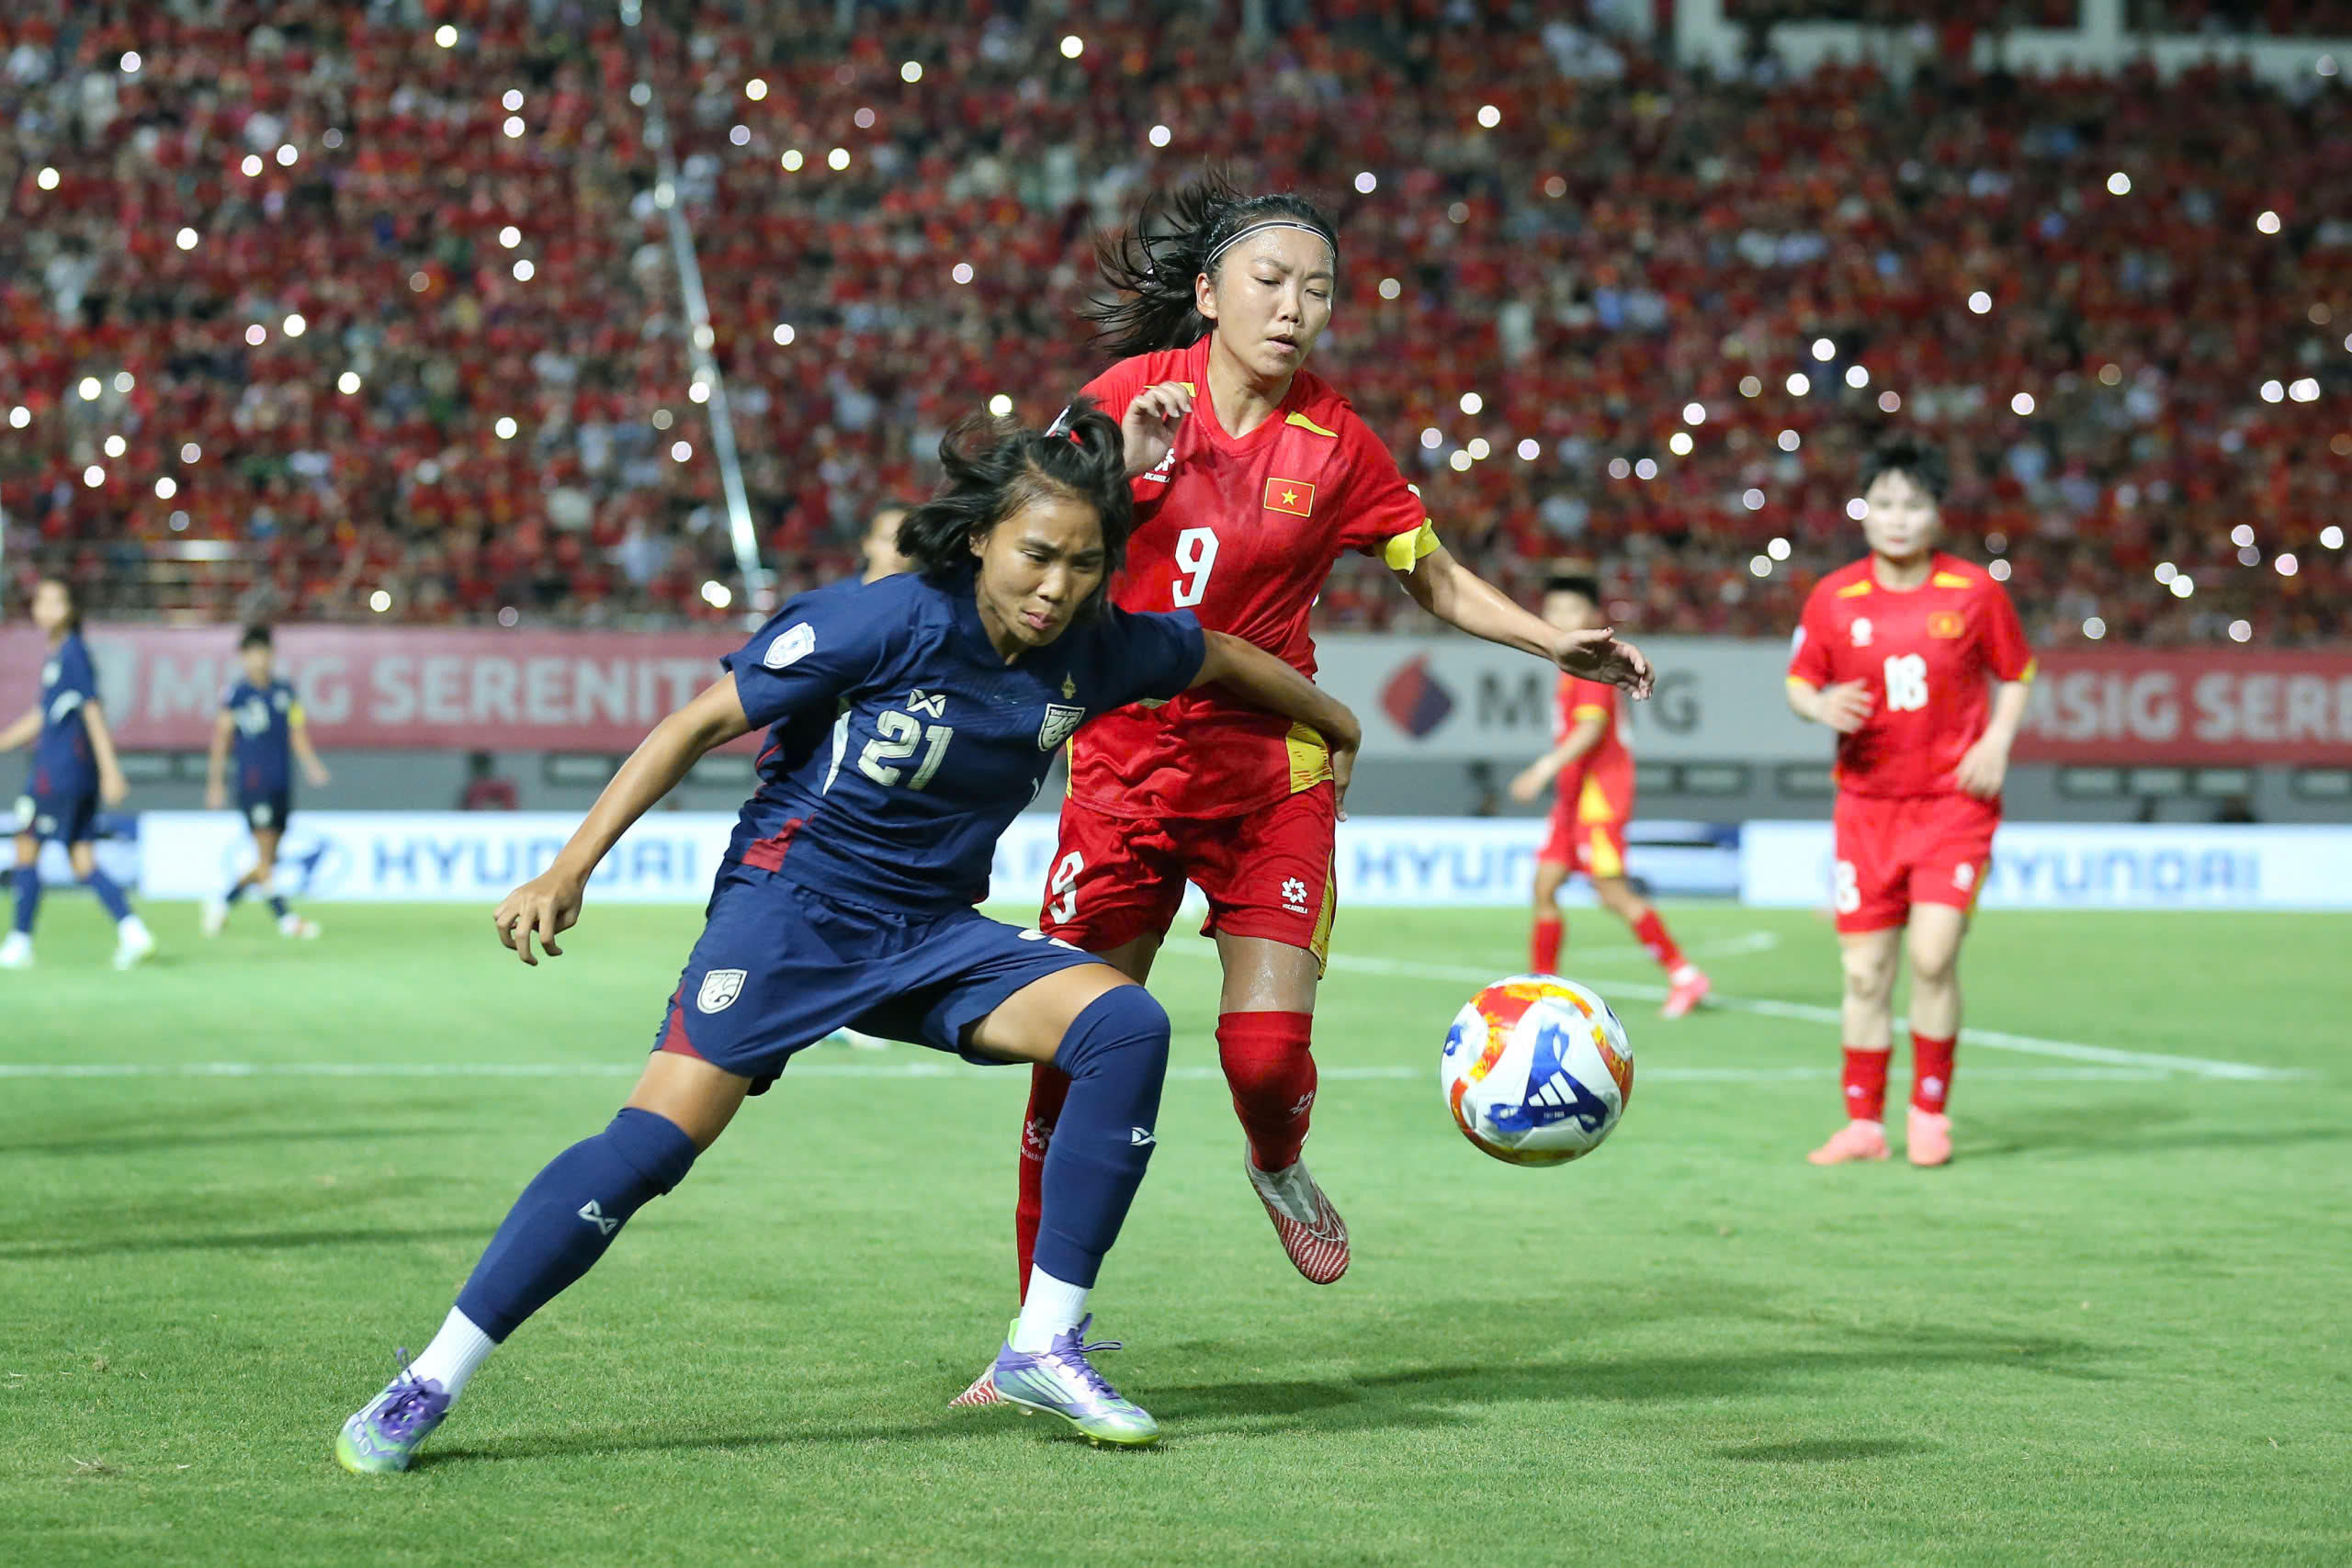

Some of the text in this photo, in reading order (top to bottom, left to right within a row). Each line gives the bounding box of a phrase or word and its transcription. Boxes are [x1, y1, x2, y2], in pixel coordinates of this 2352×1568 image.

[1172, 526, 1220, 608] 9
[149, 656, 351, 724] MG
[1476, 669, 1701, 735] MG
[1884, 653, 1928, 712] 18
[857, 710, 954, 790] 21
[1048, 851, 1085, 924] 9
